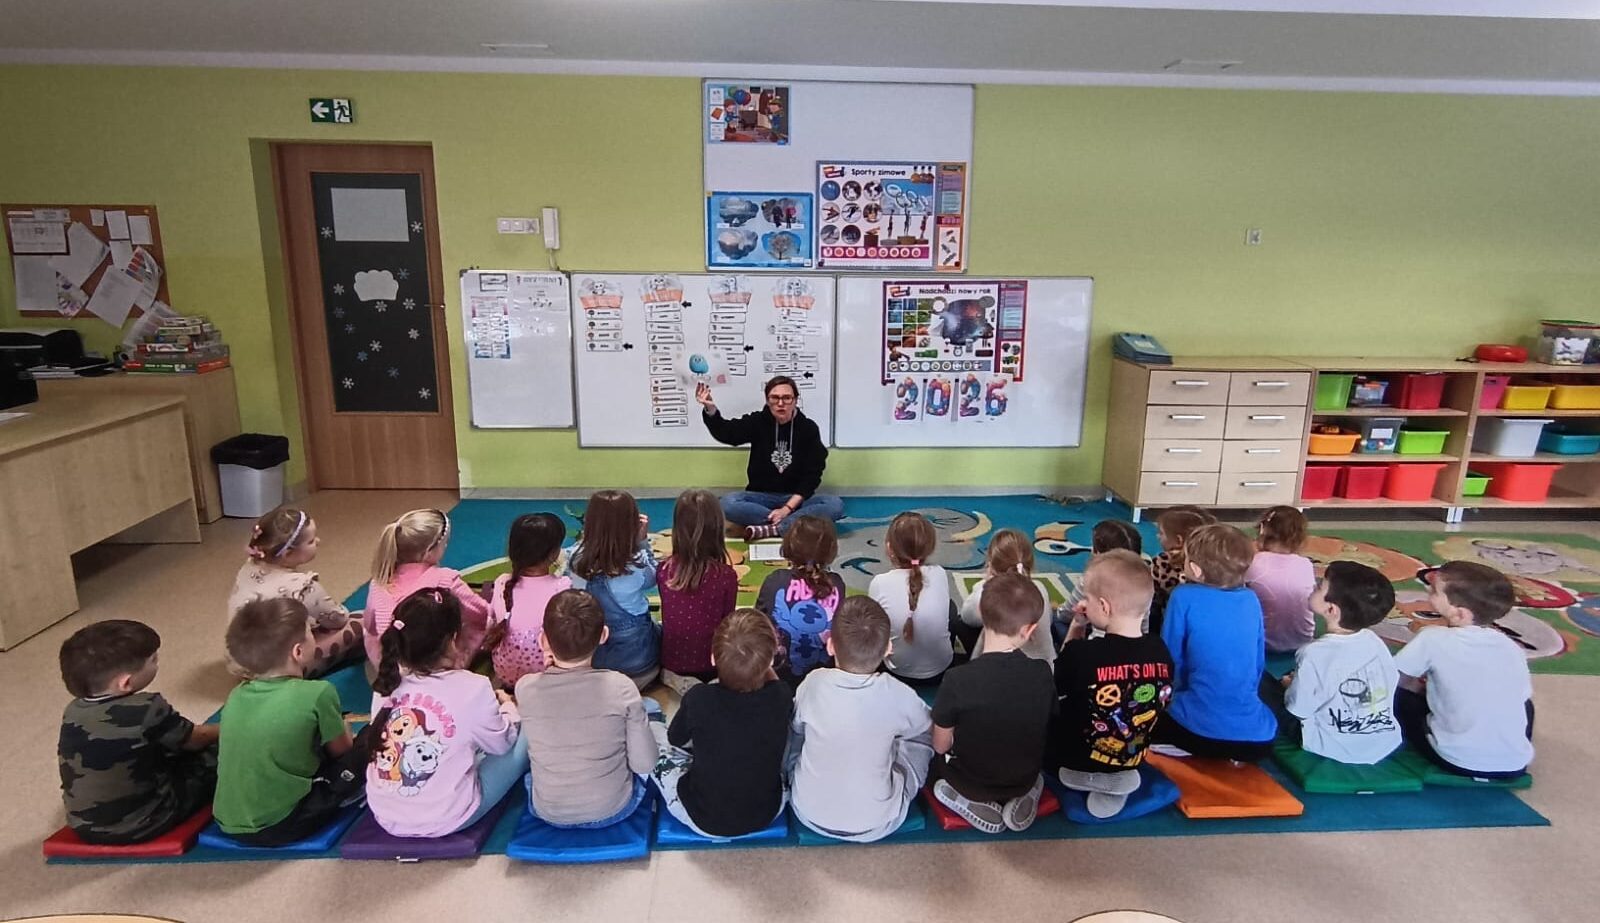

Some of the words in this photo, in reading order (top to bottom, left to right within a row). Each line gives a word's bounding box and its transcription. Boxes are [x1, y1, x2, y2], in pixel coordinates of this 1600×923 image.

[851, 168, 876, 177] Sporty
[895, 374, 1008, 420] 2026
[1097, 664, 1140, 681] WHAT'S
[1143, 664, 1156, 678] ON
